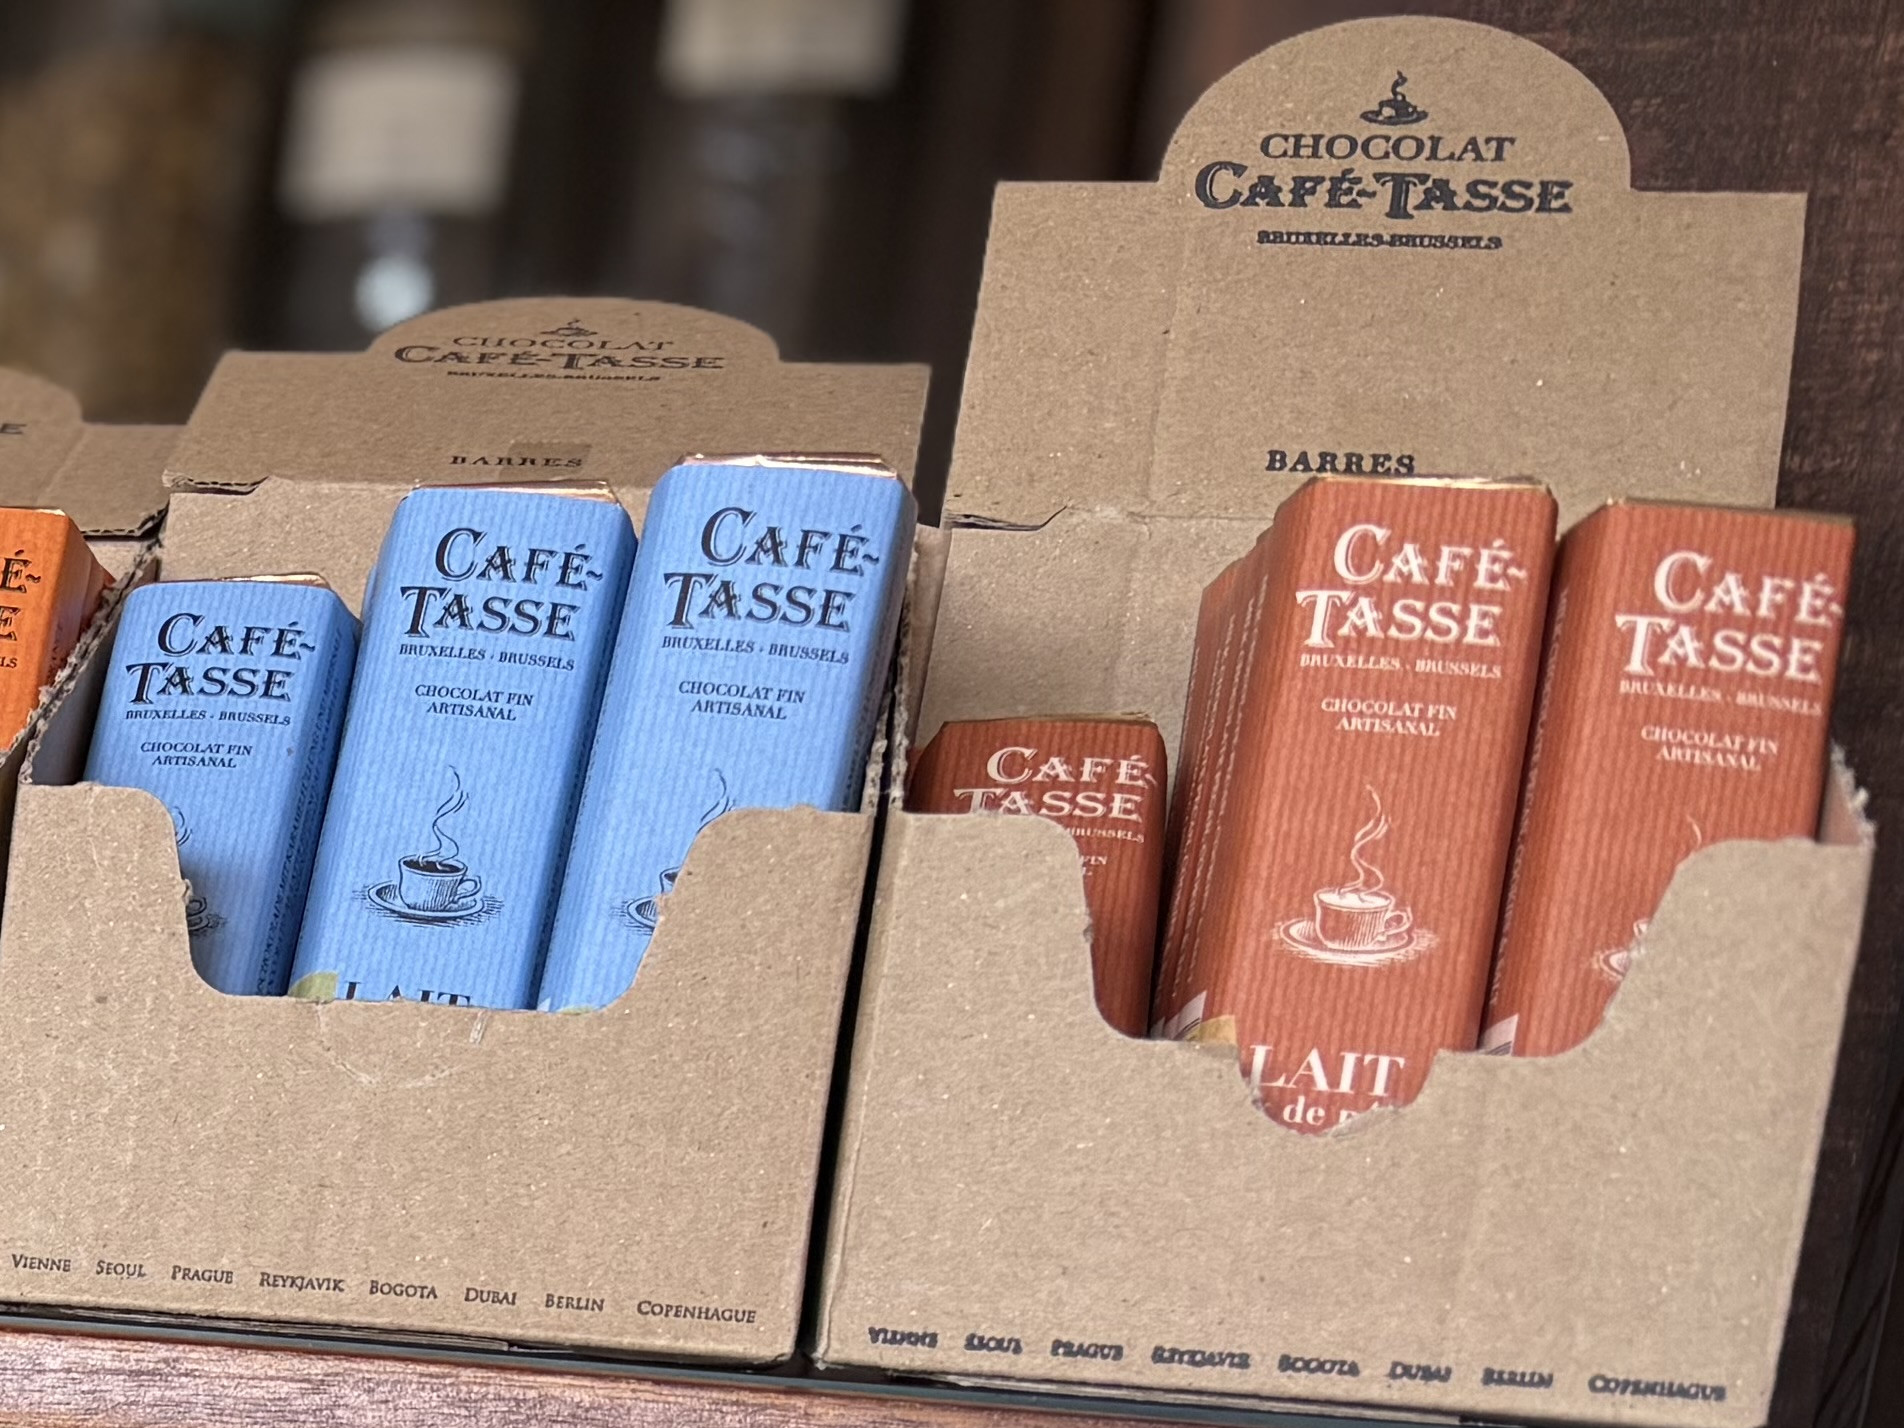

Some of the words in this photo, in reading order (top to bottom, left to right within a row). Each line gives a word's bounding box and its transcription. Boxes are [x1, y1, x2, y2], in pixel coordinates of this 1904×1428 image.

[1260, 132, 1517, 162] CHOCOLAT
[452, 335, 675, 351] CHOCOLAT
[448, 454, 584, 468] BARRES
[1265, 449, 1417, 476] BARRES
[399, 585, 581, 642] TASSE
[663, 572, 857, 633] TASSE
[1296, 589, 1503, 649] TASSE
[398, 643, 486, 661] BRUXELLES
[498, 650, 576, 671] BRUSSELS
[661, 635, 754, 654] BRUXELLES
[768, 643, 850, 665] BRUSSELS
[1616, 613, 1823, 684] TASSE
[126, 661, 295, 705] TASSE
[414, 684, 503, 703] CHOCOLAT
[507, 692, 534, 706] FIN
[679, 680, 773, 701] CHOCOLAT
[776, 689, 805, 704] FIN
[426, 702, 517, 722] ARTISANAL
[691, 700, 787, 720] ARTISANAL
[954, 787, 1144, 822] TASSE
[1249, 1045, 1405, 1098] LAIT
[1283, 1097, 1326, 1126] de
